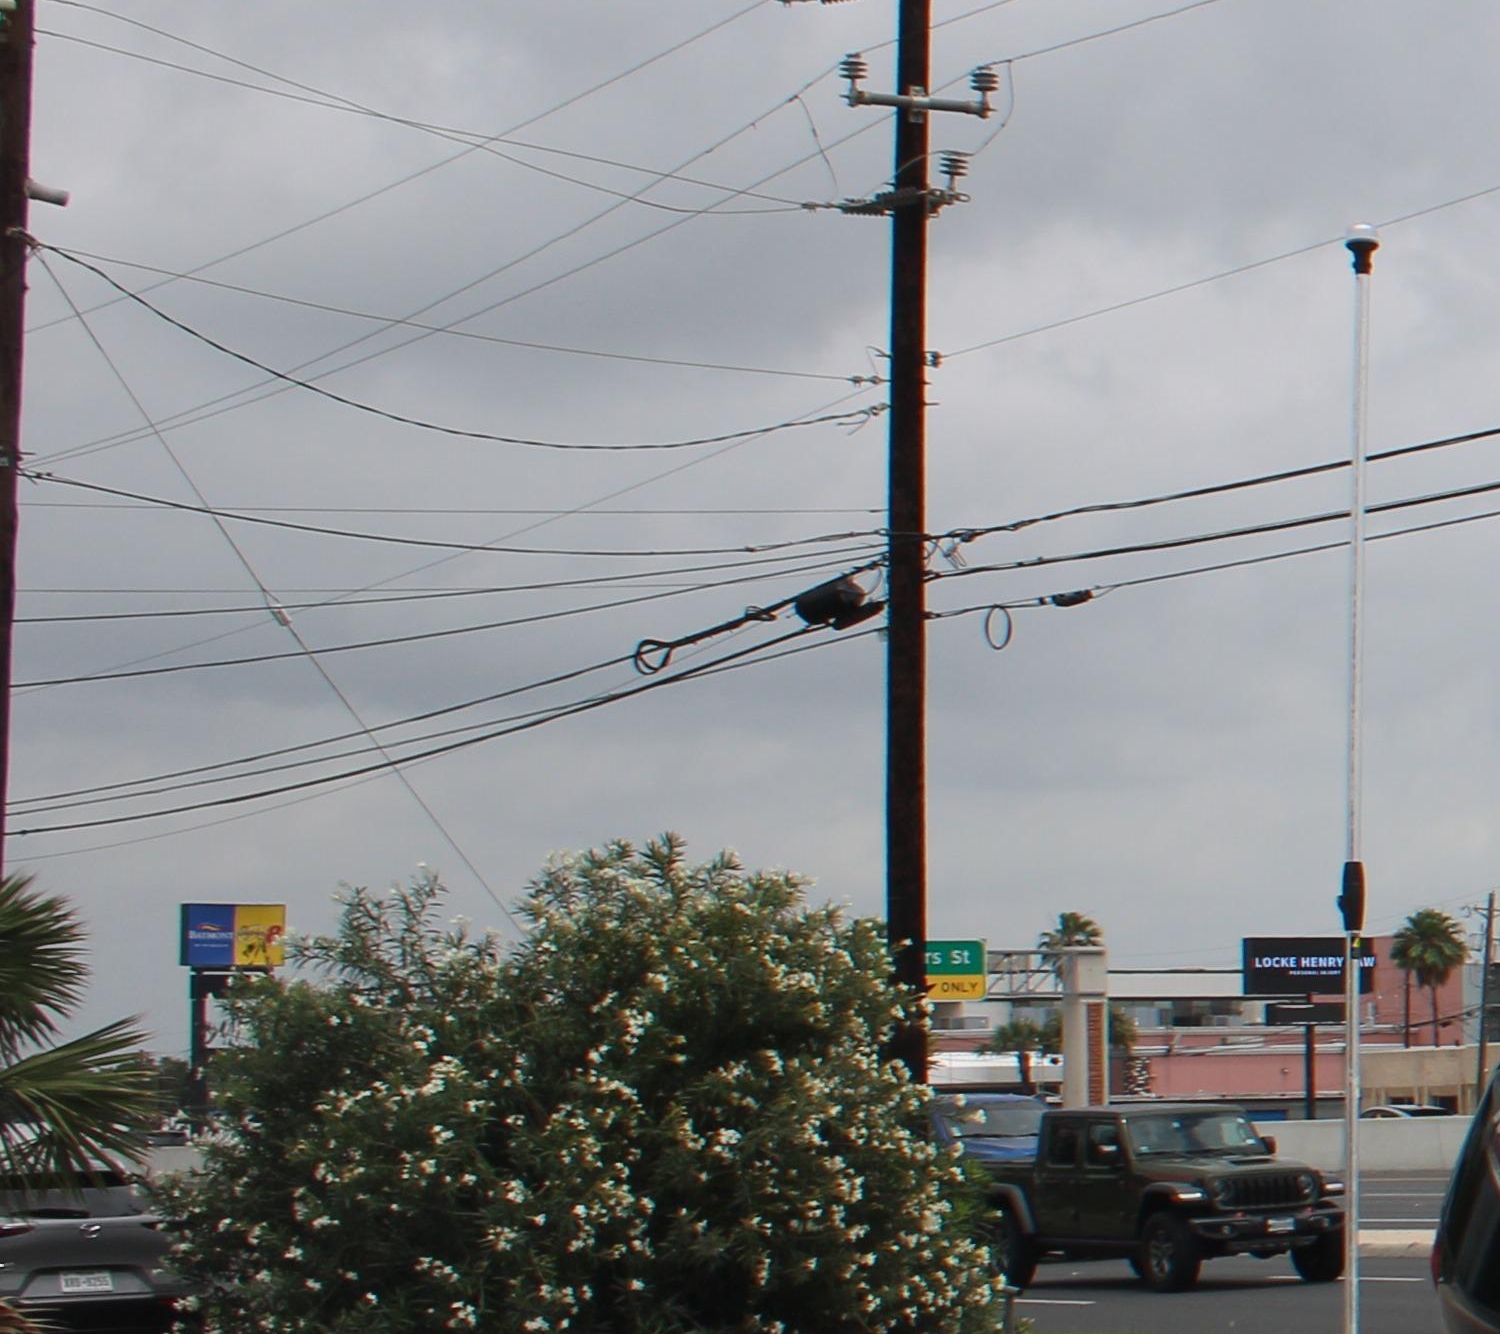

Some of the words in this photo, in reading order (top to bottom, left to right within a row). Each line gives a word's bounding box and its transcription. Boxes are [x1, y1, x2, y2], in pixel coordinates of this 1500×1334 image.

[951, 949, 971, 964] St
[1254, 956, 1297, 968] LOCKE
[1301, 956, 1345, 968] HENRY
[941, 981, 978, 994] ONLY
